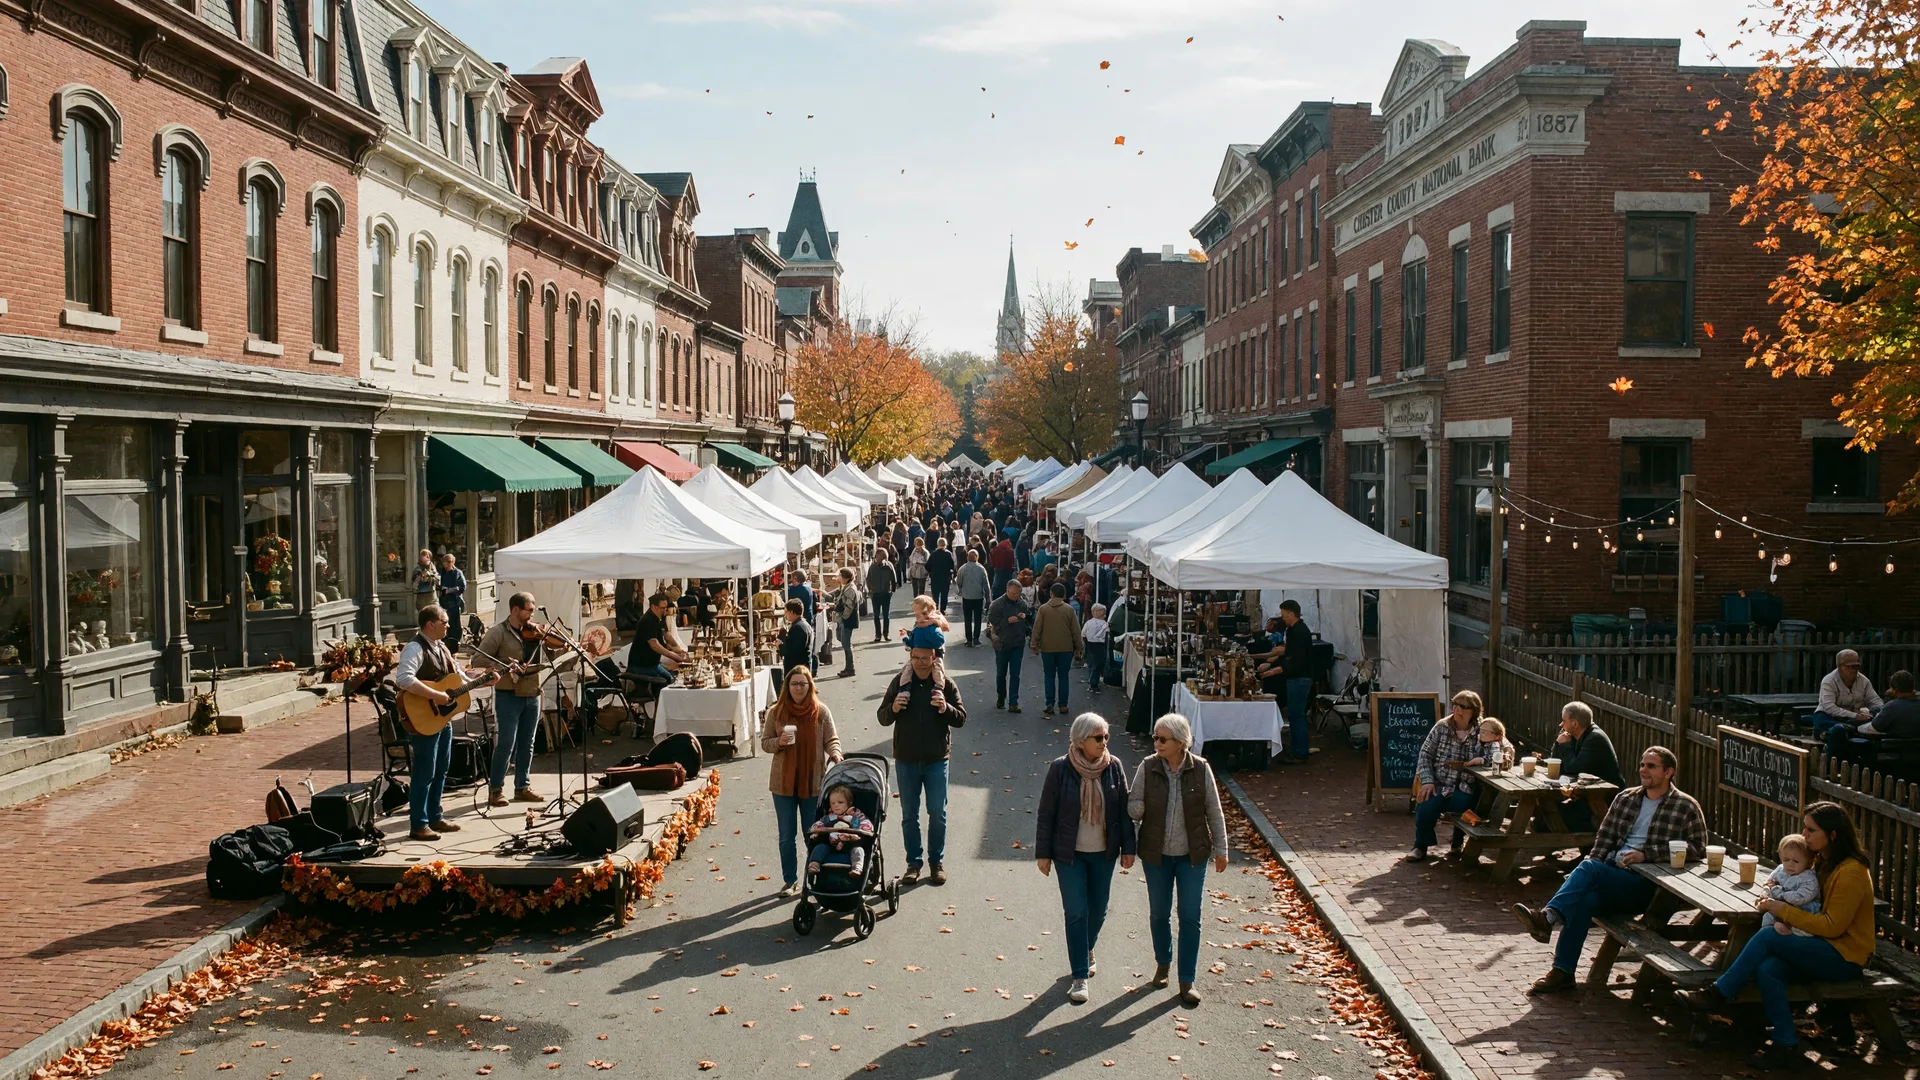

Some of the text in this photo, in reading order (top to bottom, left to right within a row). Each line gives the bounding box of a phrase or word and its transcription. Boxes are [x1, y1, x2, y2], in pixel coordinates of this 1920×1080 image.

[1537, 114, 1579, 133] 1887
[1353, 133, 1496, 234] CHESTER COUNTY NATIONAL BANK
